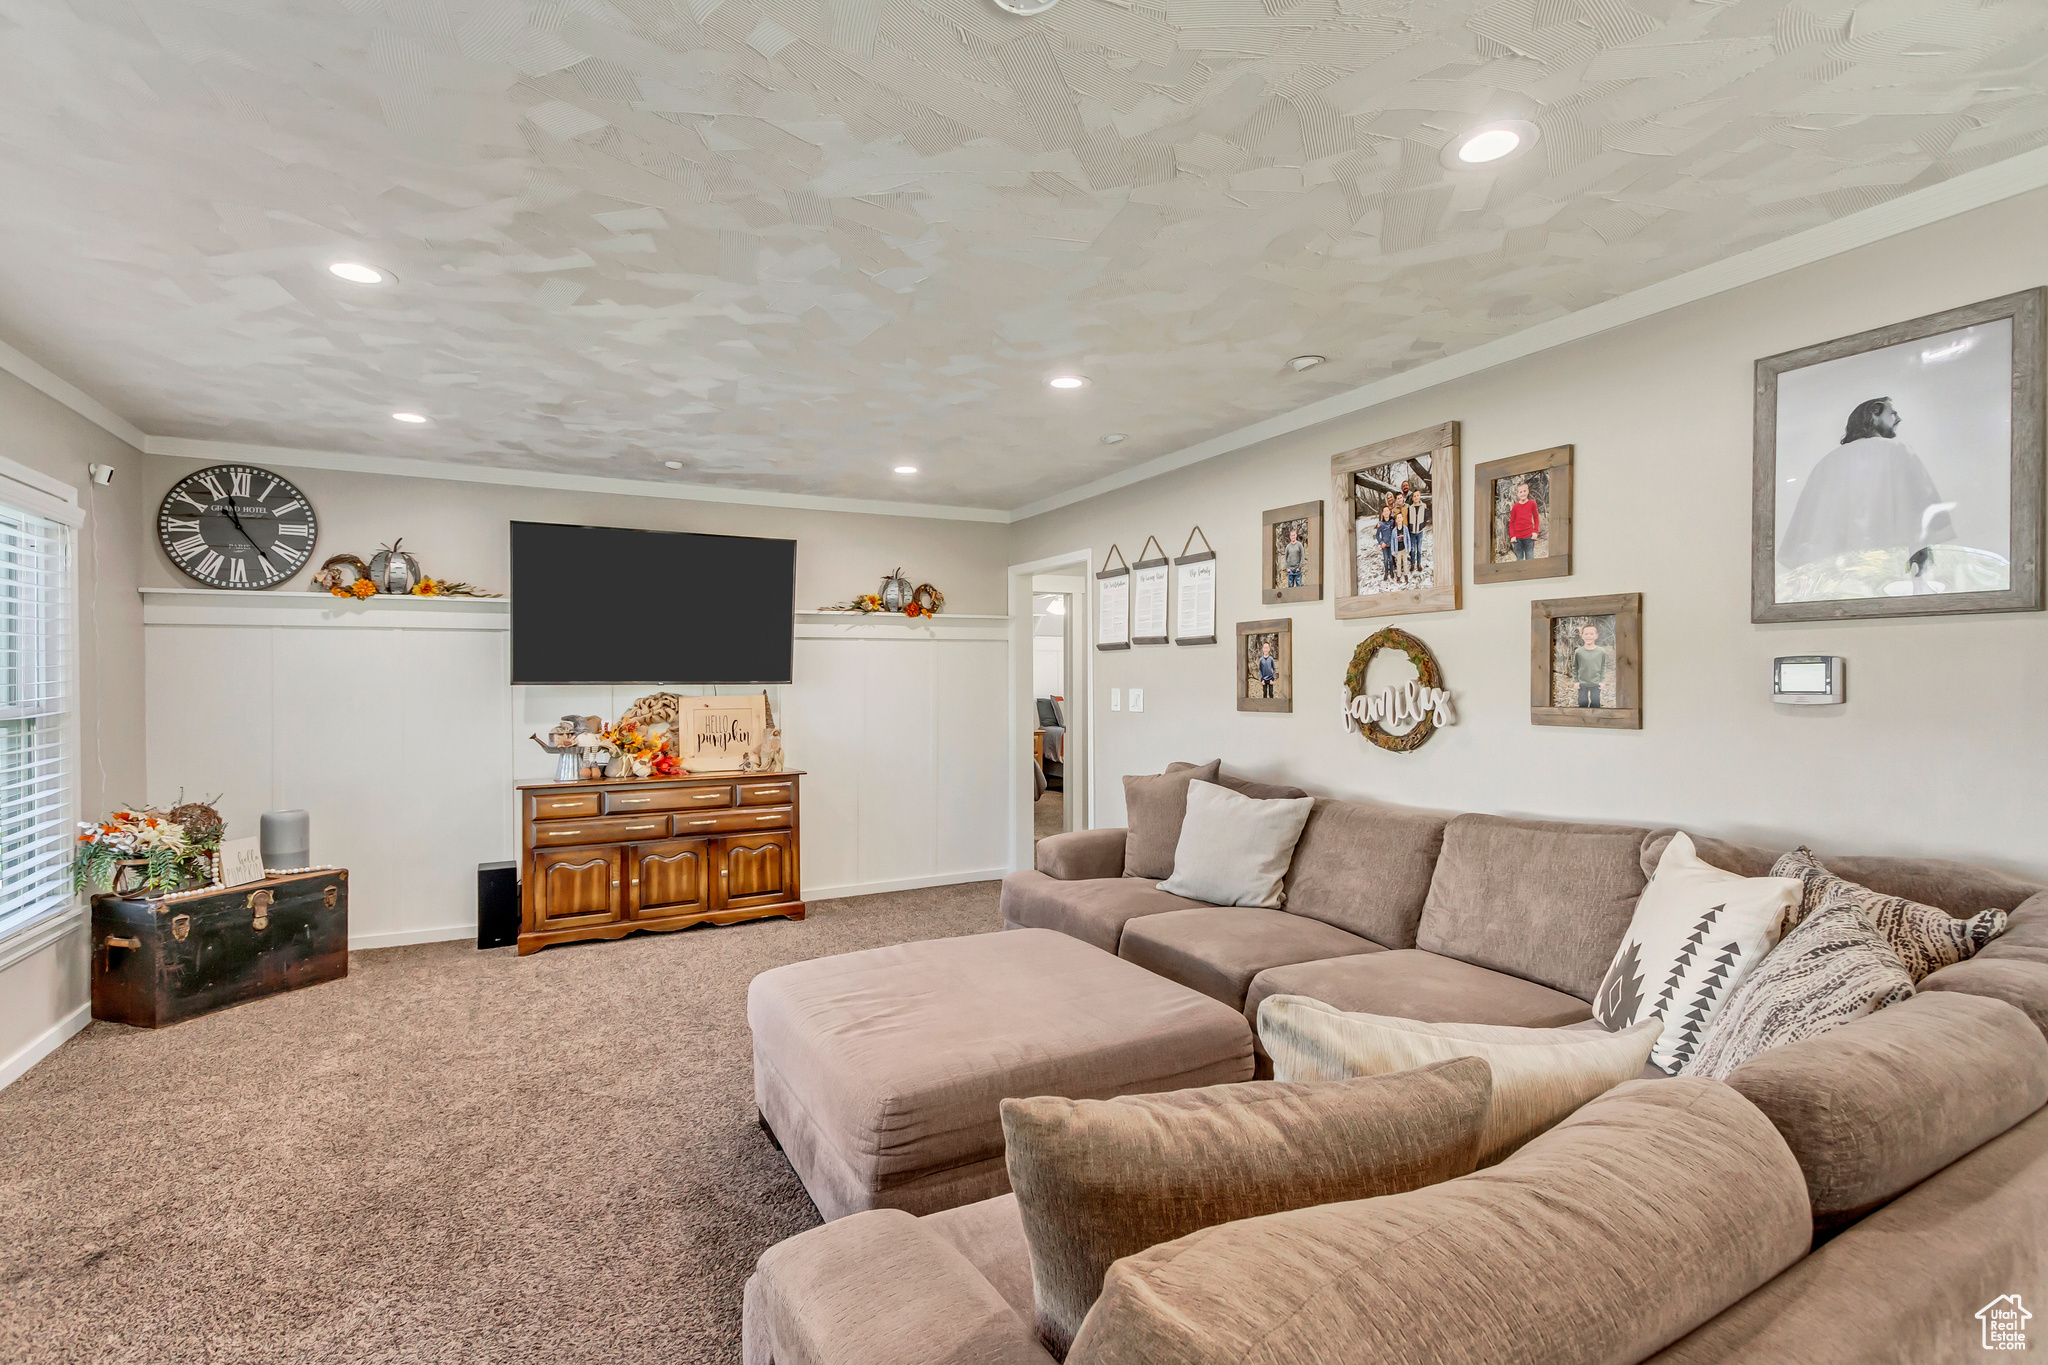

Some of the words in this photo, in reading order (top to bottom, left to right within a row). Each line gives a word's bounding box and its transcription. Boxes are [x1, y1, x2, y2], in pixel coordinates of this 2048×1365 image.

[198, 475, 229, 501] XI
[230, 472, 252, 498] XII
[257, 481, 278, 502] I
[176, 491, 208, 513] X
[210, 504, 240, 513] GRAND
[242, 506, 268, 514] HOTEL
[271, 500, 301, 517] II
[168, 517, 200, 532] IX
[278, 523, 308, 537] III
[172, 533, 209, 562] VIII
[271, 540, 301, 564] IV
[195, 550, 225, 578] VII
[229, 558, 248, 583] VI
[258, 554, 280, 578] V
[1341, 680, 1451, 733] family
[705, 714, 729, 734] HELLO
[697, 719, 751, 753] pumpkin
[237, 848, 259, 865] hello
[226, 862, 264, 885] PUMPKIN
